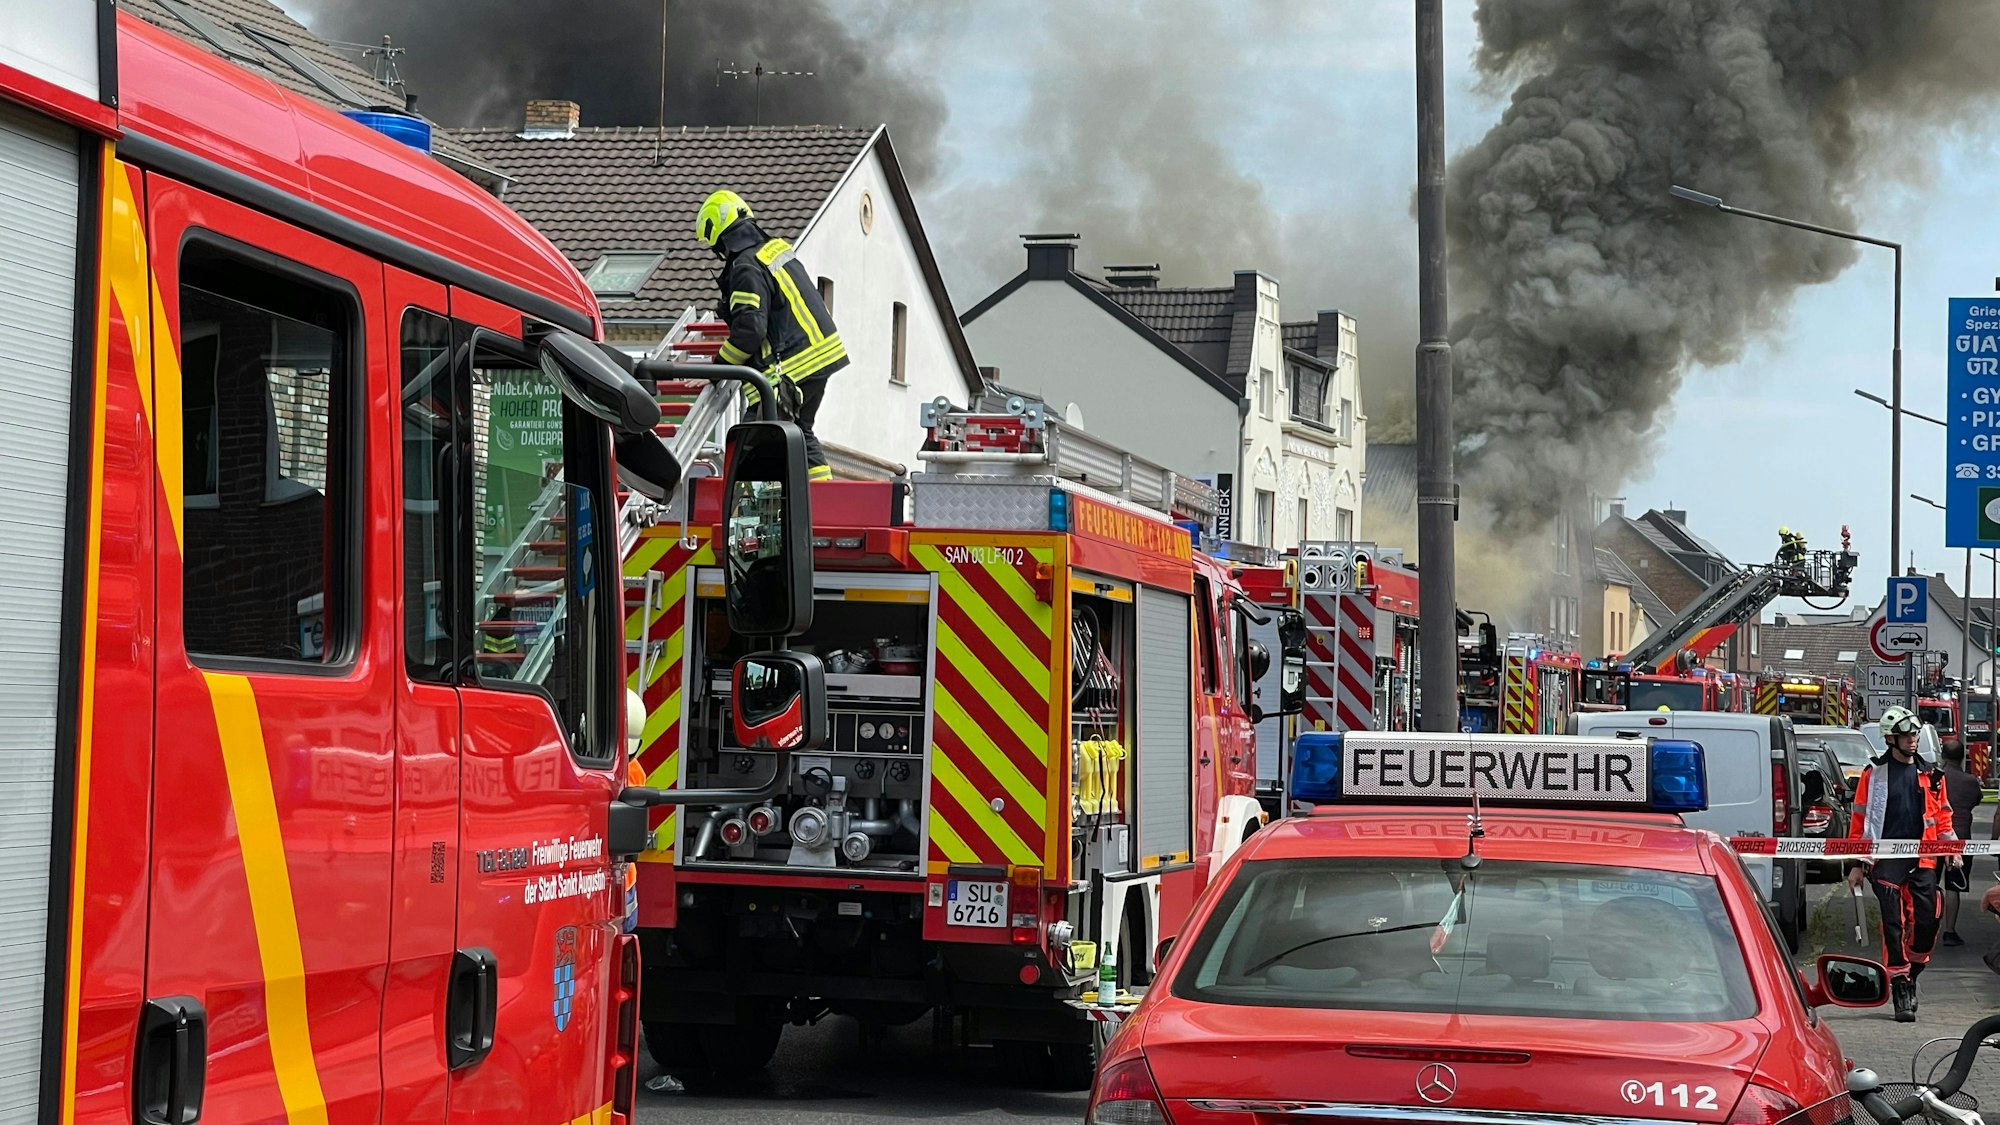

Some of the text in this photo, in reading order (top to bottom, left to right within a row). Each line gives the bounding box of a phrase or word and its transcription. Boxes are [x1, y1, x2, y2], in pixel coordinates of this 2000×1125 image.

[1969, 305, 2000, 317] Grie
[1955, 334, 2000, 354] GIA
[500, 400, 538, 417] HOHER
[1078, 500, 1172, 556] FEUERWEHR 112
[945, 546, 969, 564] SAN
[971, 547, 984, 565] 03
[1016, 548, 1024, 566] 2
[1896, 582, 1918, 618] P
[1879, 675, 1895, 686] 200
[1353, 749, 1635, 793] FEUERWEHR
[532, 833, 603, 868] Freiwillige Feuerwehr
[524, 867, 606, 905] der Stadt Sankt Augustin
[968, 884, 991, 903] SU
[954, 905, 999, 924] 6716
[1646, 1081, 1719, 1110] 112
